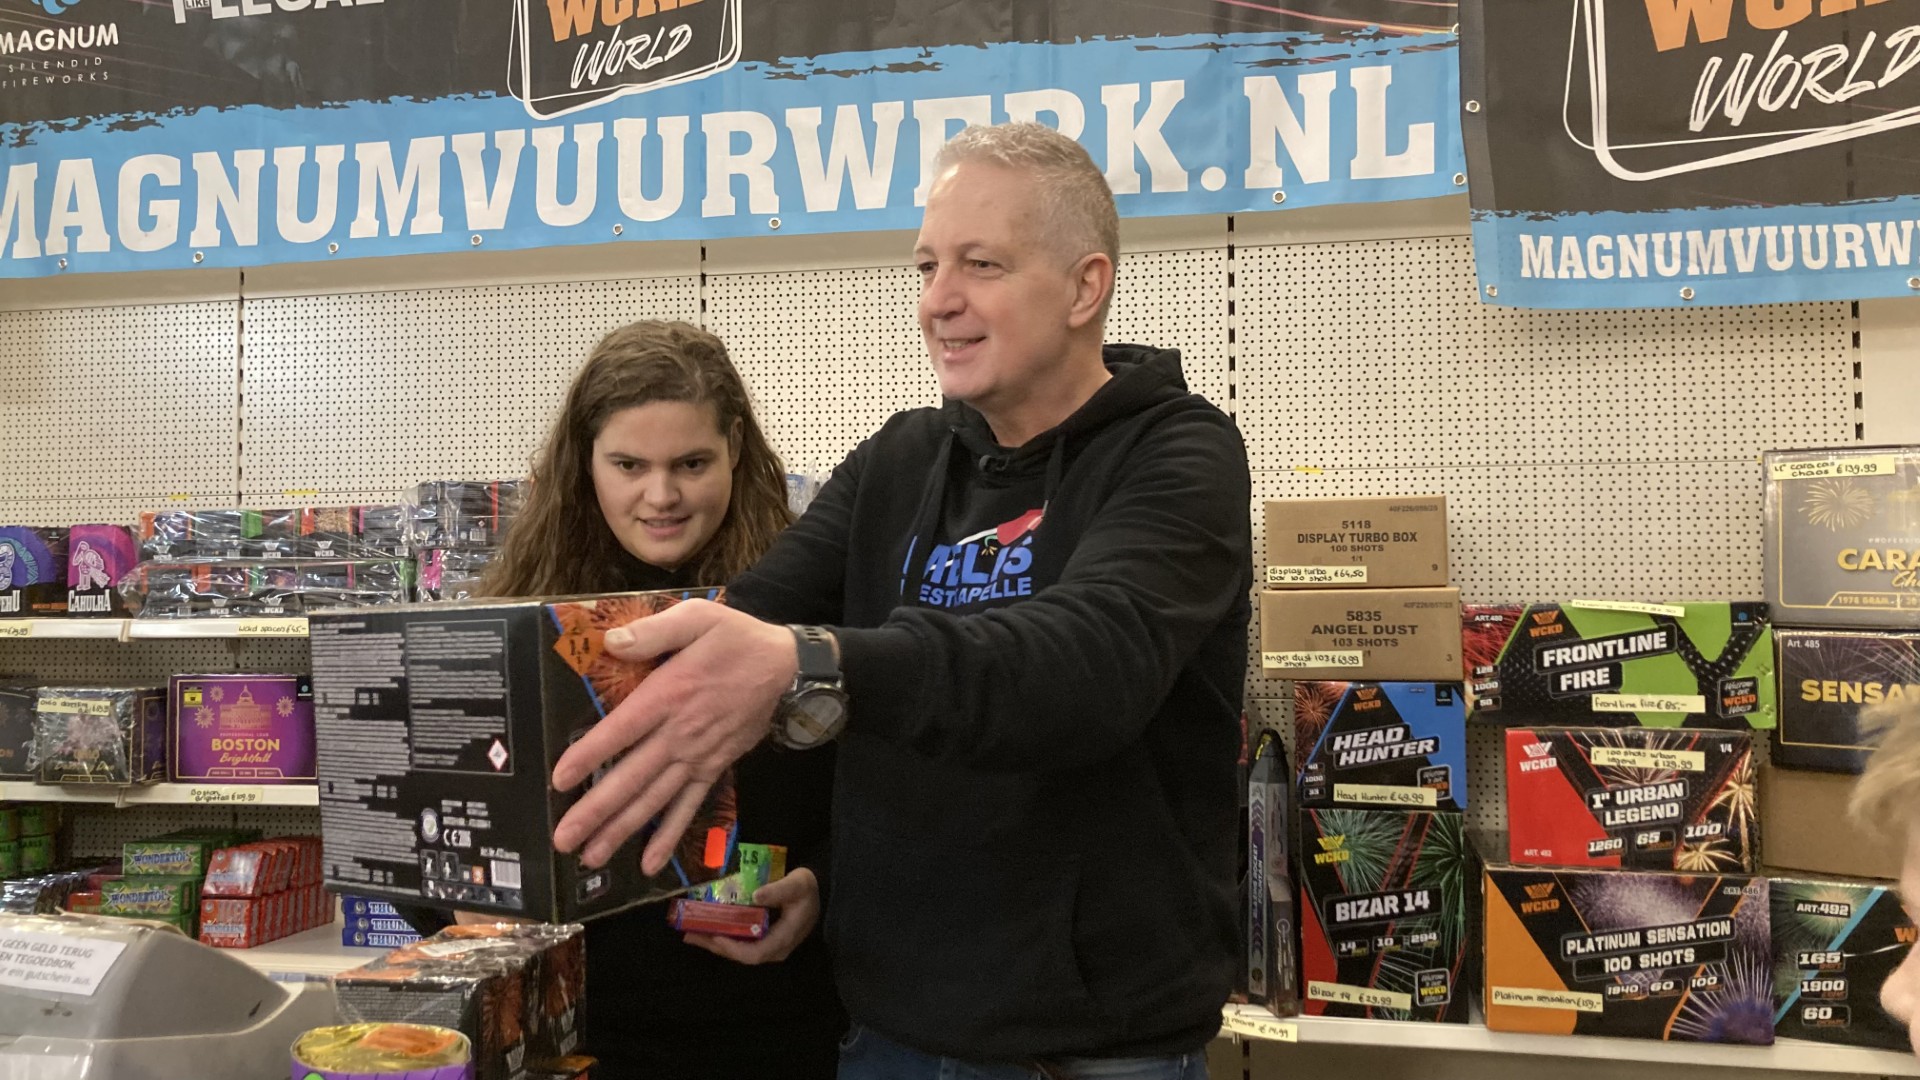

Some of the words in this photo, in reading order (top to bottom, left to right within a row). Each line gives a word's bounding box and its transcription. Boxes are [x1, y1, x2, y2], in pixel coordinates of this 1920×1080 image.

[0, 23, 119, 55] MAGNUM
[571, 25, 693, 88] WORLD
[8, 56, 102, 73] SPLENDID
[3, 71, 109, 89] FIREWORKS
[1520, 219, 1920, 280] MAGNUMVUURW
[1341, 520, 1372, 530] 5118
[1297, 532, 1345, 544] DISPLAY
[1348, 532, 1390, 544] TURBO
[1392, 531, 1418, 543] BOX
[1330, 544, 1348, 553] 100
[1350, 544, 1385, 552] SHOTS
[1269, 567, 1302, 576] display
[1304, 567, 1327, 575] turbo
[1309, 573, 1333, 582] shots
[1346, 610, 1381, 622] 5835
[1311, 624, 1368, 635] ANGEL
[1373, 624, 1419, 635] DUST
[1529, 624, 1563, 637] WCKD
[1331, 638, 1353, 647] 103
[1356, 638, 1399, 647] SHOTS
[1542, 631, 1668, 668] FRONTLINE
[1804, 639, 1821, 649] 485
[1265, 653, 1289, 664] Angel
[1292, 653, 1312, 662] dust
[1560, 667, 1611, 698] FIRE
[1353, 699, 1382, 712] WCKD
[1723, 694, 1756, 707] WCKD
[211, 738, 280, 752] BOSTON
[1332, 726, 1405, 752] HEAD
[1338, 738, 1435, 767] HUNTER
[1720, 743, 1733, 753] 1/4
[219, 752, 273, 767] Brightfall
[1518, 757, 1557, 773] WCKD
[1336, 790, 1357, 801] Head
[1361, 791, 1388, 801] Hunter
[1615, 782, 1684, 805] URBAN
[1604, 801, 1680, 827] LEGEND
[1685, 823, 1722, 838] 100
[1588, 838, 1623, 851] 1260
[1636, 831, 1661, 845] 65
[1314, 850, 1350, 864] WCKD
[1336, 894, 1400, 922] BIZAR
[1403, 890, 1431, 913] 14
[1520, 899, 1560, 915] WCKD
[1566, 931, 1641, 956] PLATINUM
[1646, 920, 1732, 945] SENSATION
[2, 939, 30, 951] GEEN
[30, 943, 58, 954] GELD
[59, 945, 95, 959] TERUG
[1603, 957, 1632, 975] 100
[1639, 948, 1696, 969] SHOTS
[1798, 952, 1841, 965] 165
[1650, 980, 1674, 992] 60
[1691, 976, 1718, 989] 100
[1801, 980, 1845, 993] 1900
[1310, 984, 1335, 998] Bizar
[1420, 985, 1447, 996] WCKD
[1803, 1006, 1833, 1020] 60
